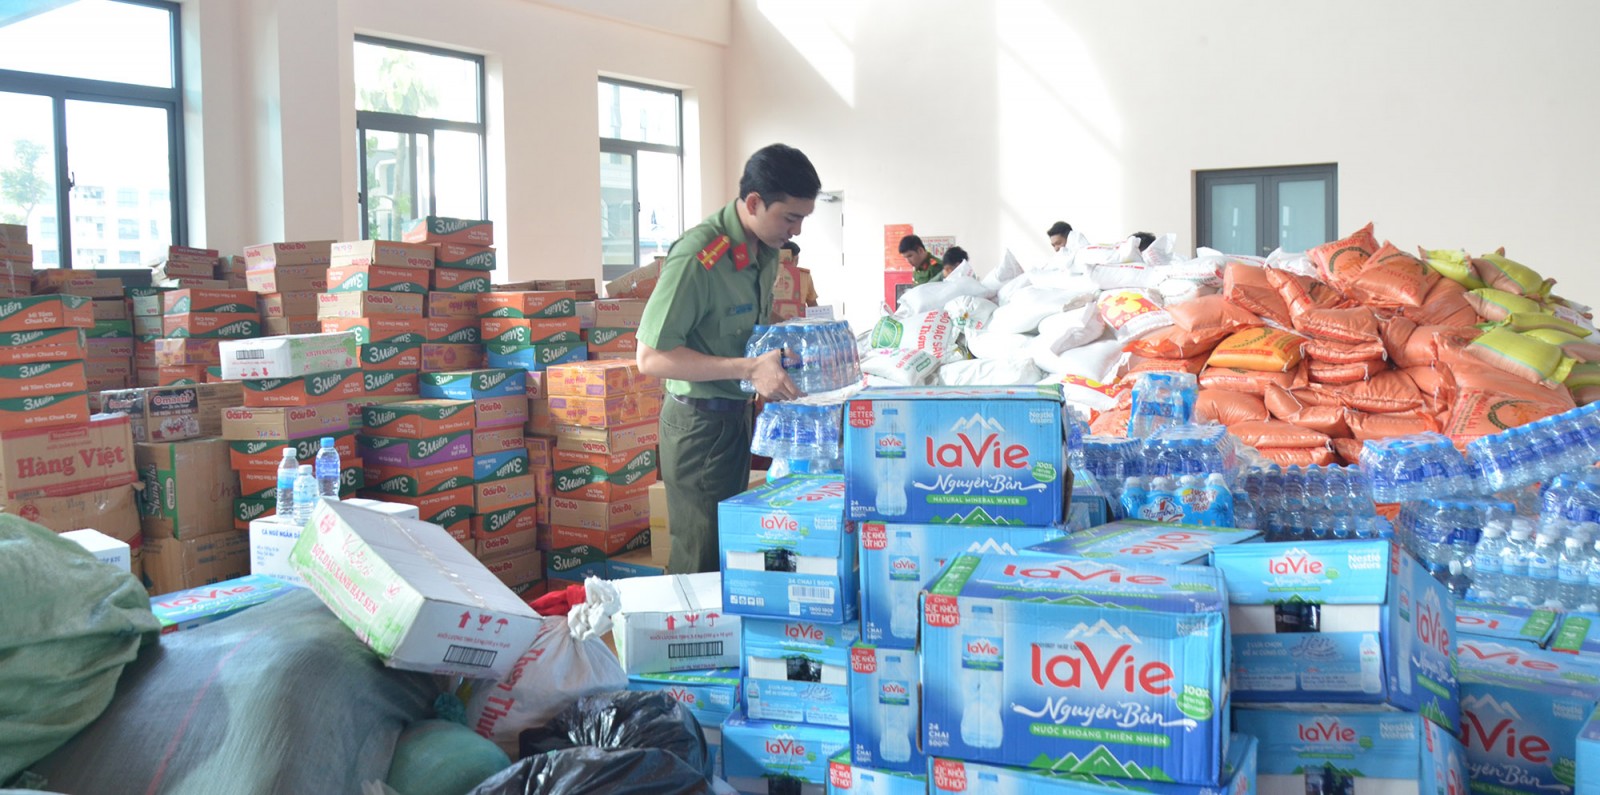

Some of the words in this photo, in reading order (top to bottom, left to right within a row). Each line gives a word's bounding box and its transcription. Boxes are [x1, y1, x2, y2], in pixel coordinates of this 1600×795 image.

[849, 410, 874, 419] BETTER
[879, 437, 902, 447] laVie
[926, 433, 1030, 469] laVie
[16, 455, 76, 480] Hàng
[79, 445, 125, 468] Việt
[930, 474, 990, 494] Nguyên
[989, 475, 1030, 492] Bản
[932, 496, 964, 504] NATURAL
[996, 497, 1021, 505] WATER
[761, 516, 798, 531] laVie
[893, 560, 917, 571] laVie
[1269, 557, 1323, 574] laVie
[1348, 553, 1380, 562] Nestlé
[1003, 564, 1167, 585] laVie
[157, 585, 256, 609] laVie
[363, 594, 380, 616] SEN
[925, 603, 940, 614] SỨC
[940, 604, 959, 614] KHỎE
[925, 613, 942, 624] TỐT
[942, 614, 960, 625] HƠN
[785, 623, 824, 640] laVie
[1416, 601, 1449, 656] laVie
[967, 643, 998, 655] laVie
[1031, 641, 1175, 695] laVie
[668, 688, 694, 704] aVie
[882, 685, 905, 693] laVie
[1036, 696, 1122, 726] Nguyên
[1117, 701, 1170, 728] Bản
[1033, 724, 1059, 734] NƯỚC
[1062, 726, 1102, 739] KHOÁNG
[1104, 731, 1133, 742] THIÊN
[1136, 734, 1167, 746] NHIÊN
[1298, 721, 1356, 743] laVie
[766, 740, 804, 756] laVie
